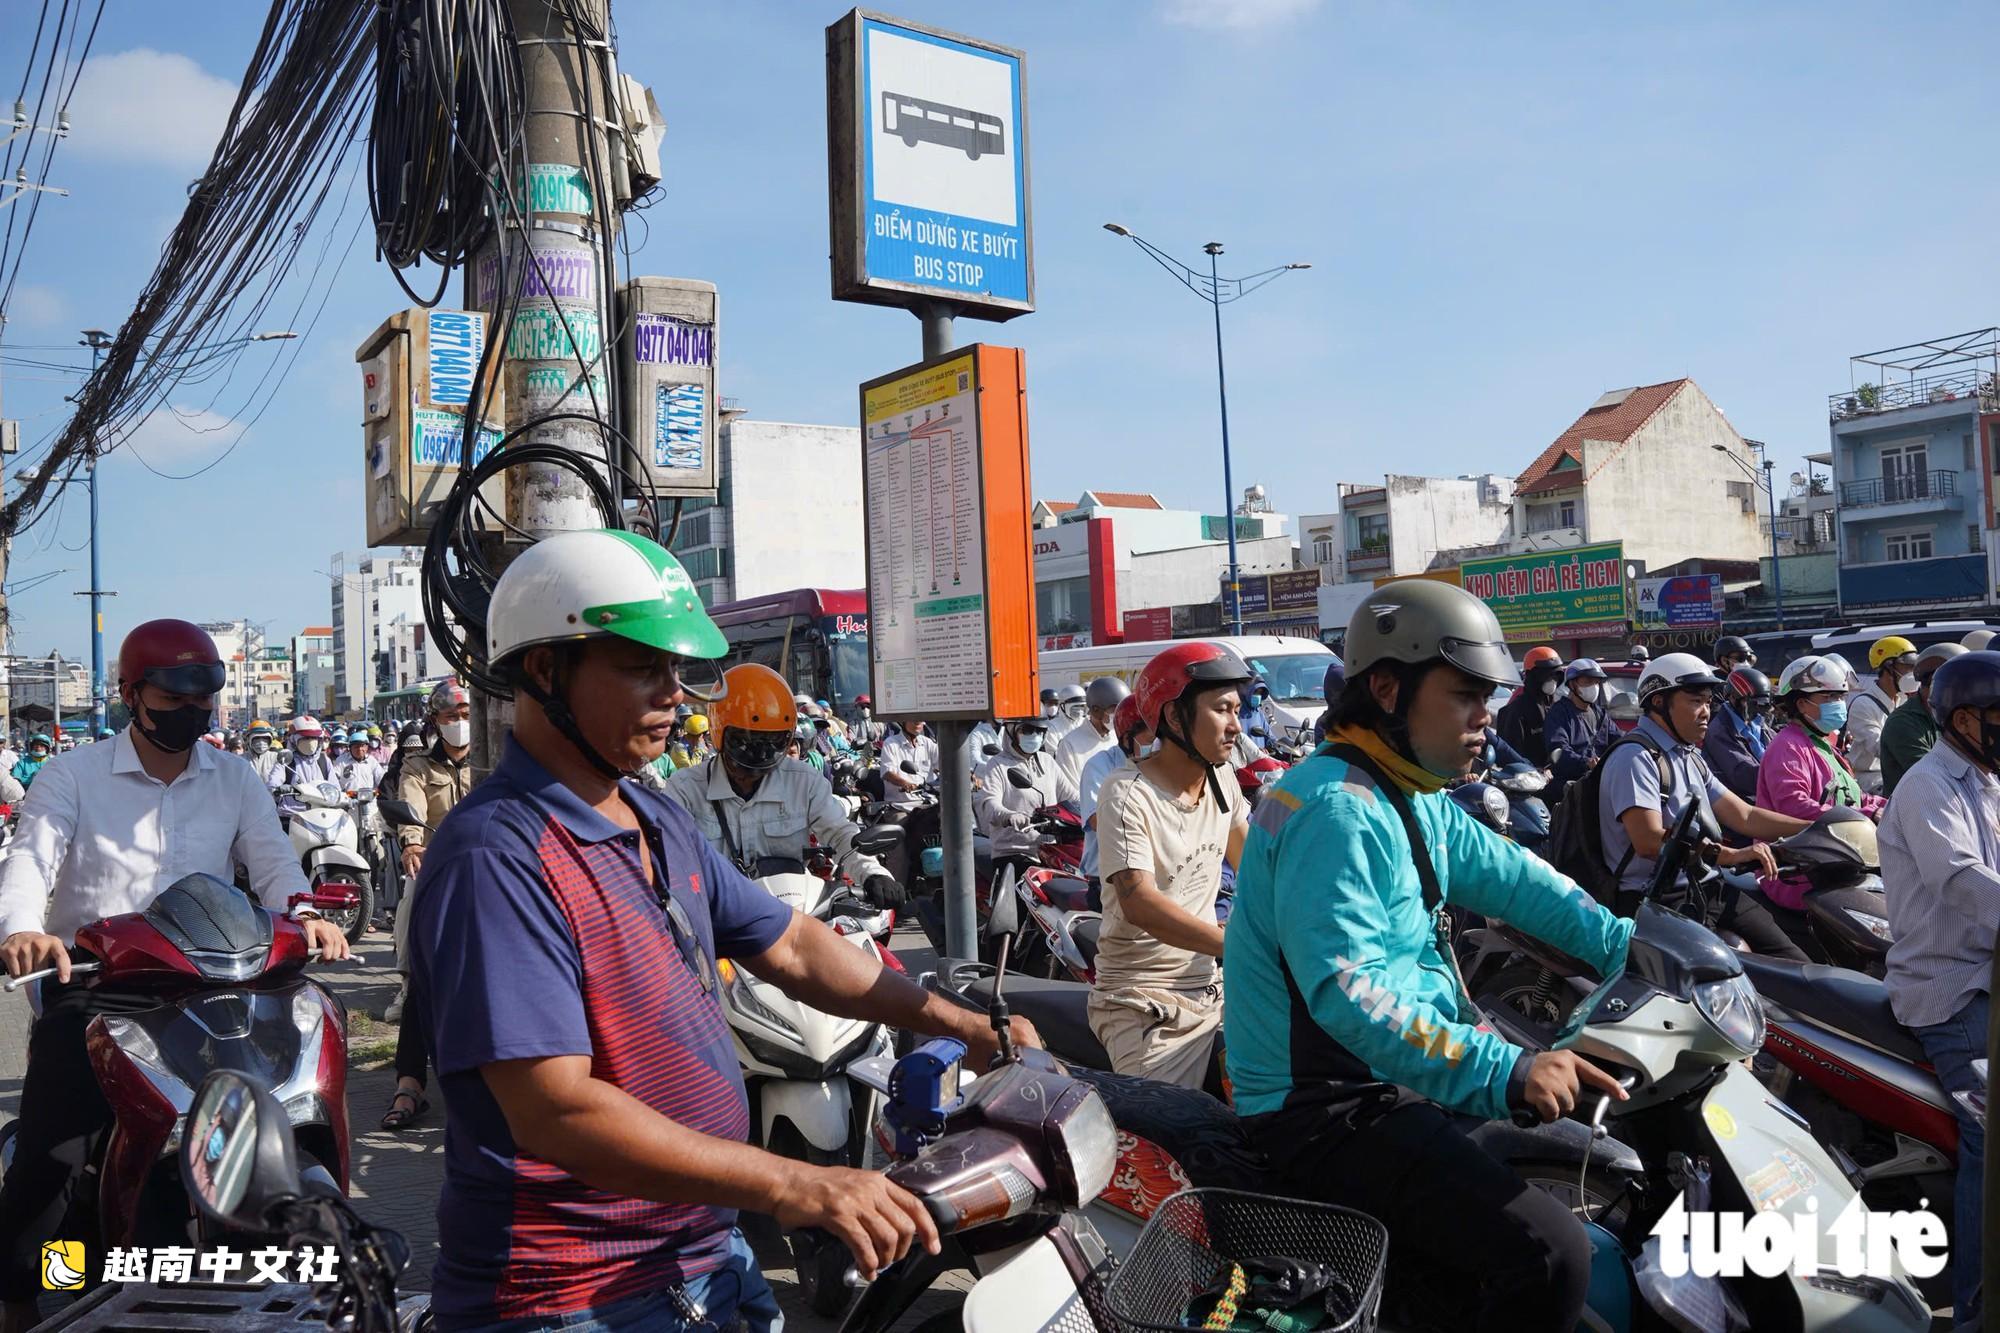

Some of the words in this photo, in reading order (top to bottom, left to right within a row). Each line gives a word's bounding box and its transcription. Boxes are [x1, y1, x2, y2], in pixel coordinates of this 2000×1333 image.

[874, 208, 912, 241] ĐIỂM
[916, 217, 957, 250] DỪNG
[961, 230, 979, 254] XE
[983, 232, 1018, 260] BUÝT
[914, 255, 943, 281] BUS
[947, 262, 984, 287] STOP
[474, 317, 482, 337] HUT
[415, 411, 434, 420] HUT
[1466, 573, 1493, 600] KHO
[1496, 565, 1529, 603] NỆM
[1533, 560, 1559, 595] GIÁ
[1560, 556, 1581, 592] RẺ
[1584, 558, 1621, 589] HCM
[1640, 588, 1654, 601] AK
[203, 994, 240, 1004] HONDA
